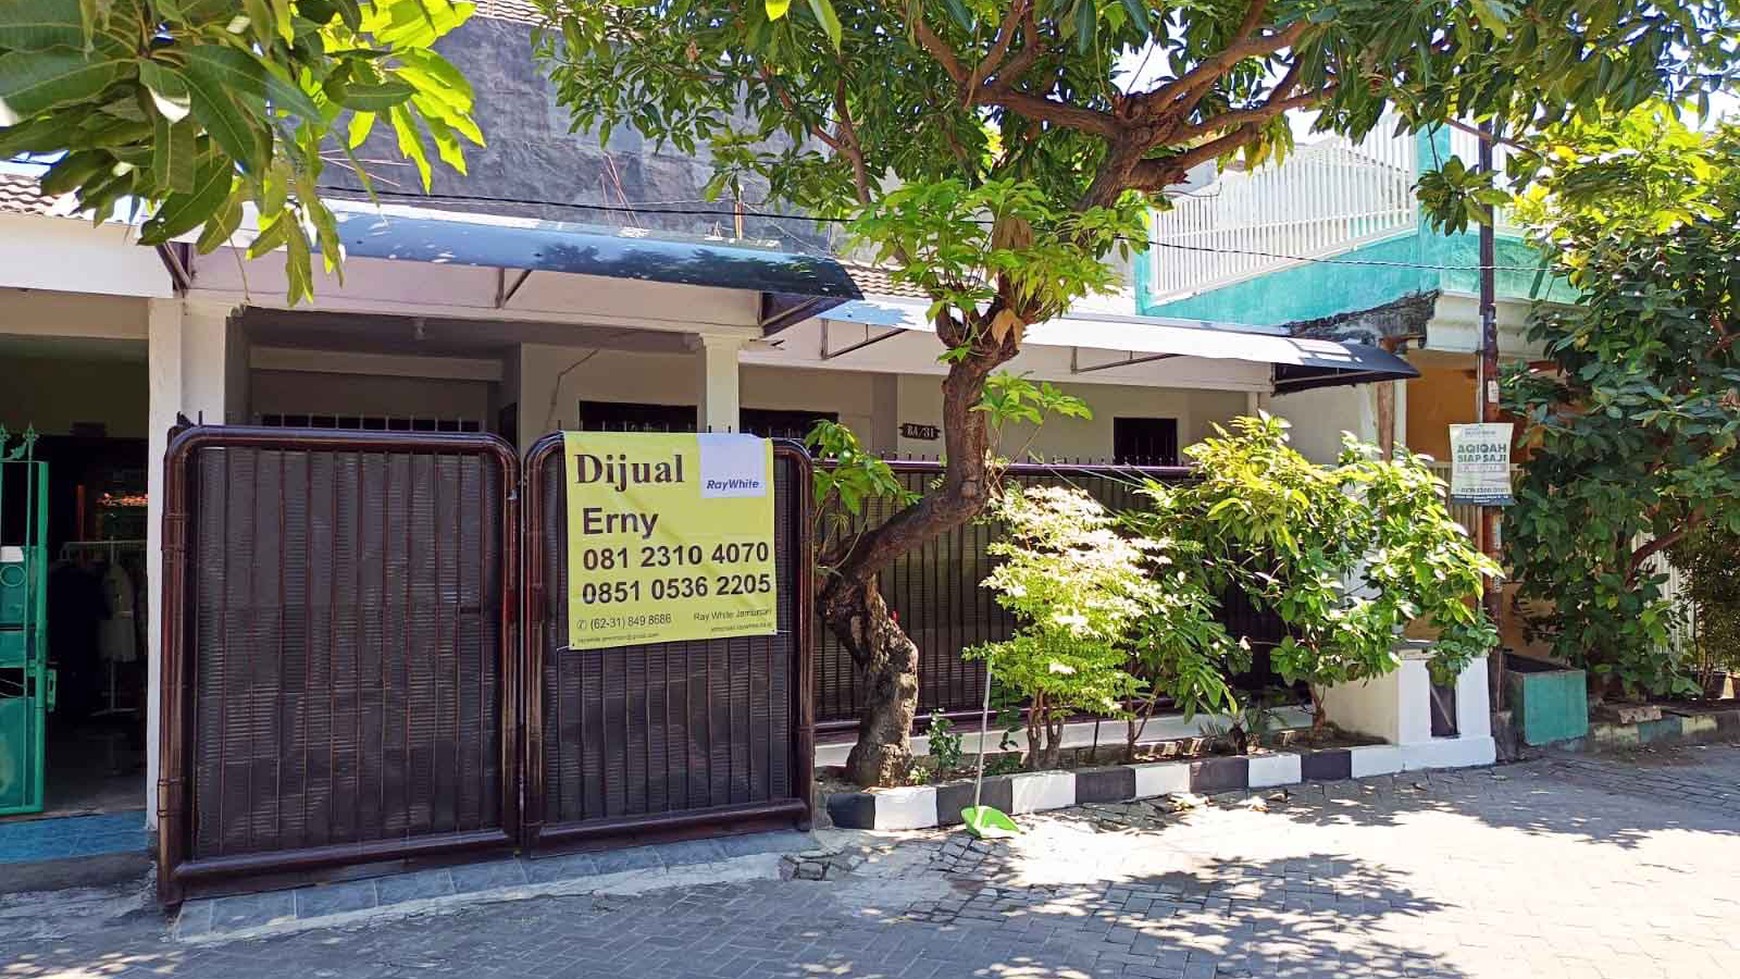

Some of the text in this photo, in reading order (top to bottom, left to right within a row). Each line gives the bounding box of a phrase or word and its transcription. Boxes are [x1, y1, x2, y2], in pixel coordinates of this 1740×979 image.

[1457, 444, 1507, 453] AQIQAH
[1457, 454, 1507, 463] SIAP SAJI
[574, 454, 685, 493] Dijual
[706, 479, 760, 491] RayWhite
[583, 507, 659, 540] Erny
[583, 542, 769, 571] 081 2310 4070
[582, 573, 771, 604] 0851 0536 2205
[590, 617, 625, 631] (62-31)
[627, 615, 646, 627] 849
[693, 611, 710, 622] Ray
[711, 610, 734, 620] White
